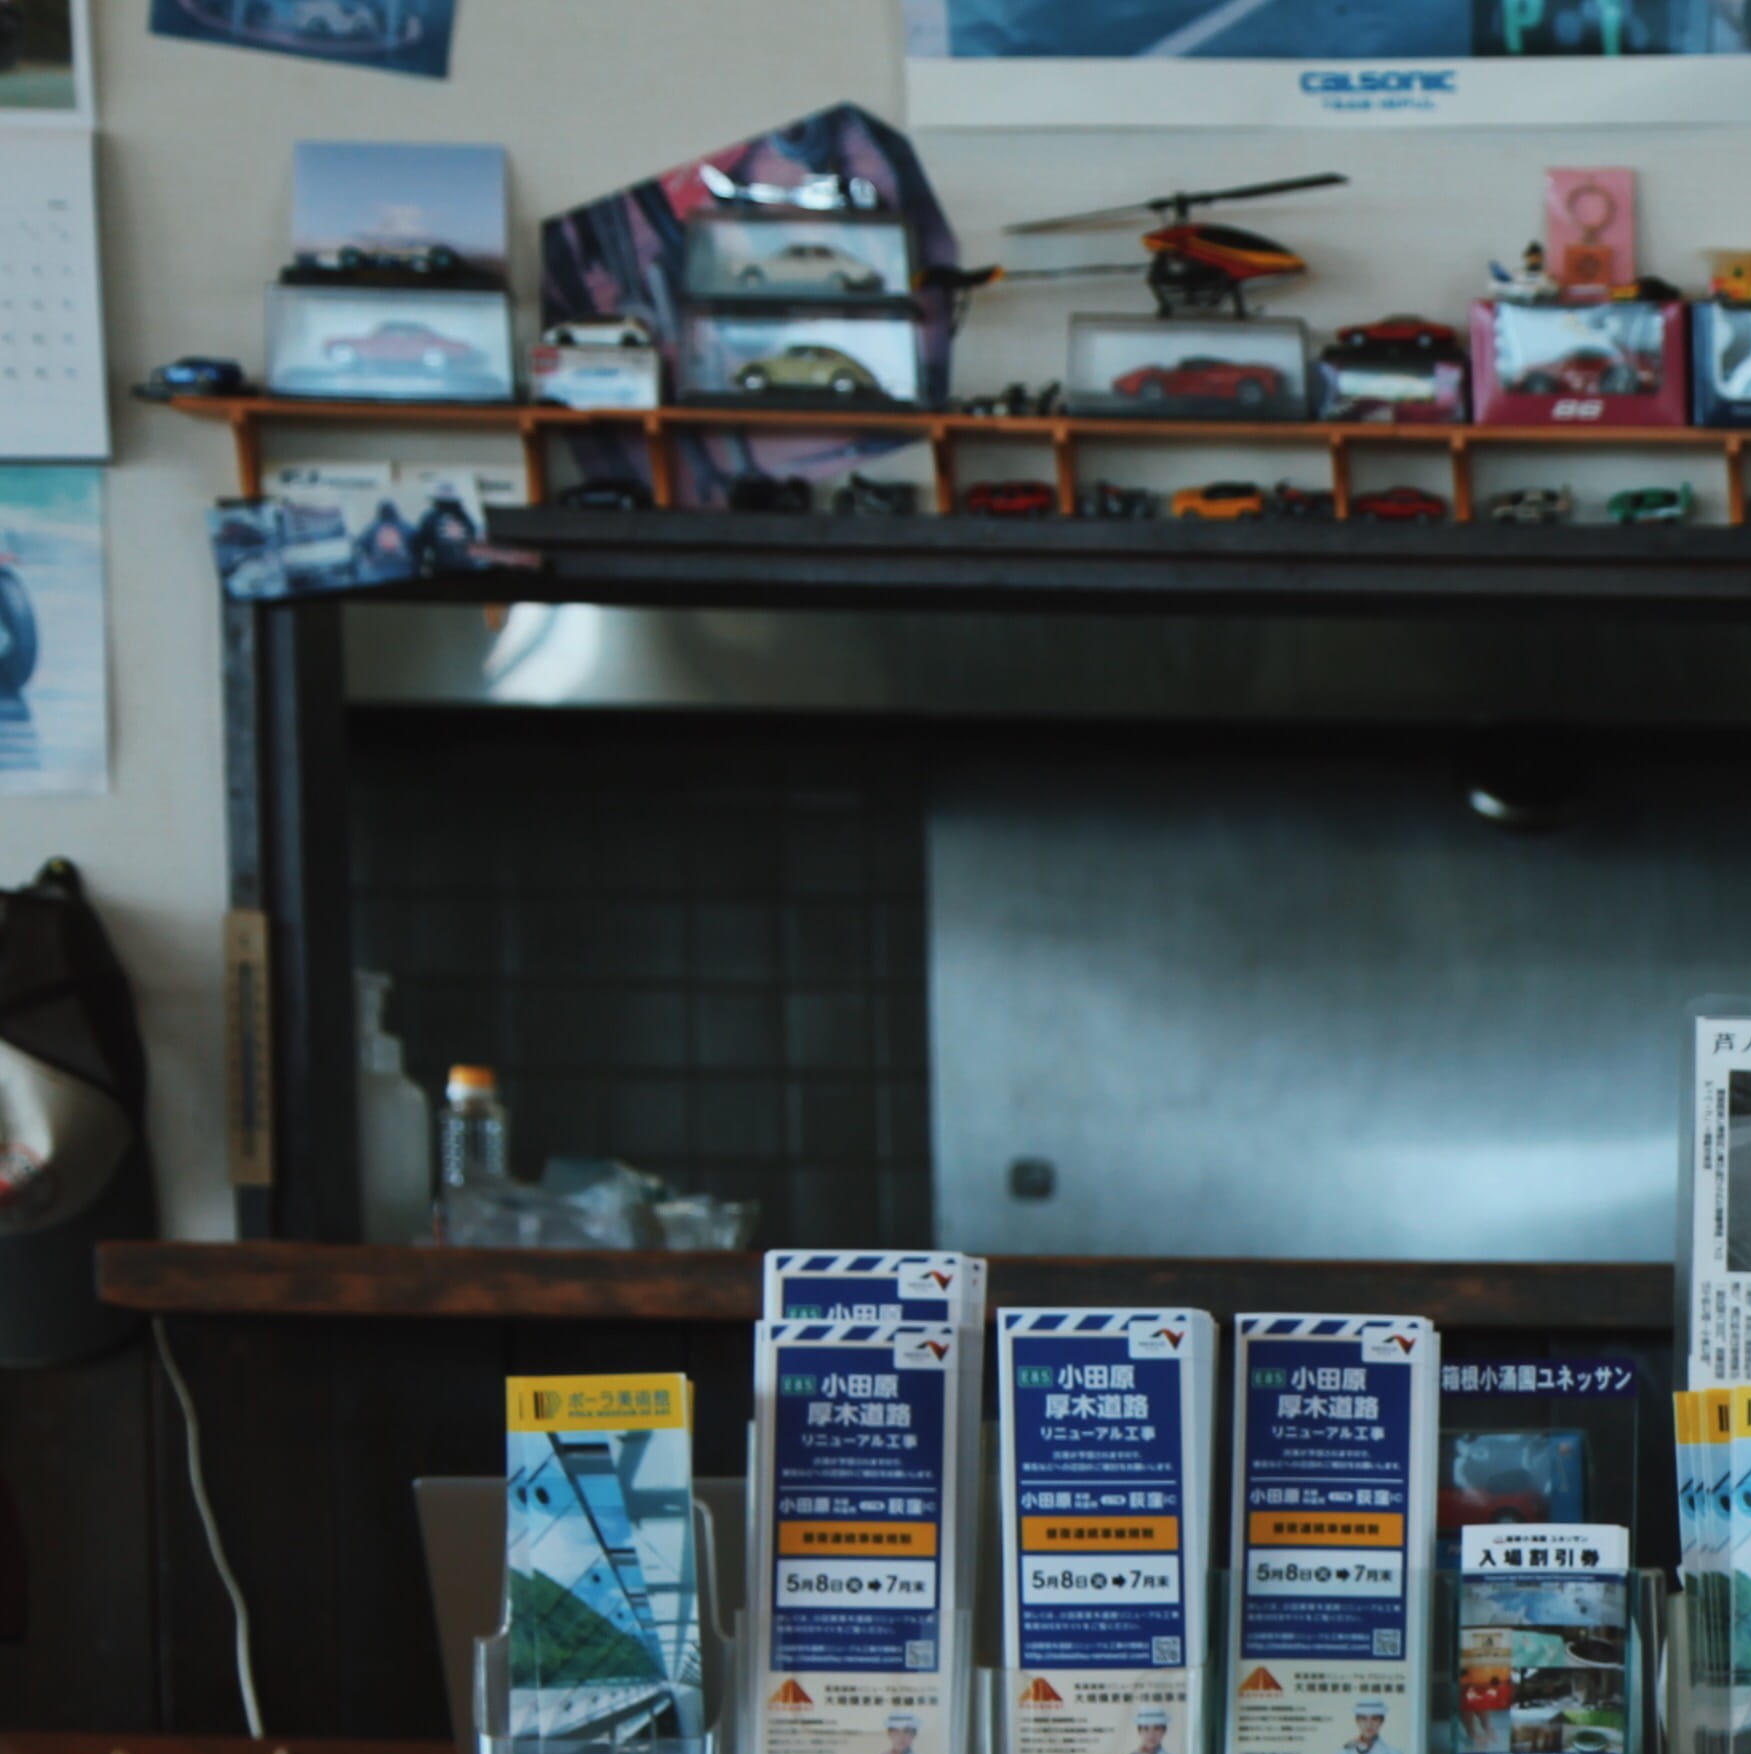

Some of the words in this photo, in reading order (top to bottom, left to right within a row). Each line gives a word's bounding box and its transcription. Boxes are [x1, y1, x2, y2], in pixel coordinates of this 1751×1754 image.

[821, 1373, 898, 1399] 小田原
[1058, 1365, 1135, 1390] 小田原
[1291, 1367, 1366, 1391] 小田原
[1441, 1365, 1633, 1392] 箱根小涌園ユネッサン
[808, 1402, 911, 1427] 厚木道路
[1045, 1394, 1148, 1419] 厚木道路
[1277, 1394, 1379, 1419] 厚木道路
[802, 1434, 918, 1449] リニューアル工事
[1041, 1427, 1155, 1441] リニューアル工事
[1272, 1426, 1385, 1440] リニューアル工事
[1479, 1548, 1600, 1567] 入場割引券
